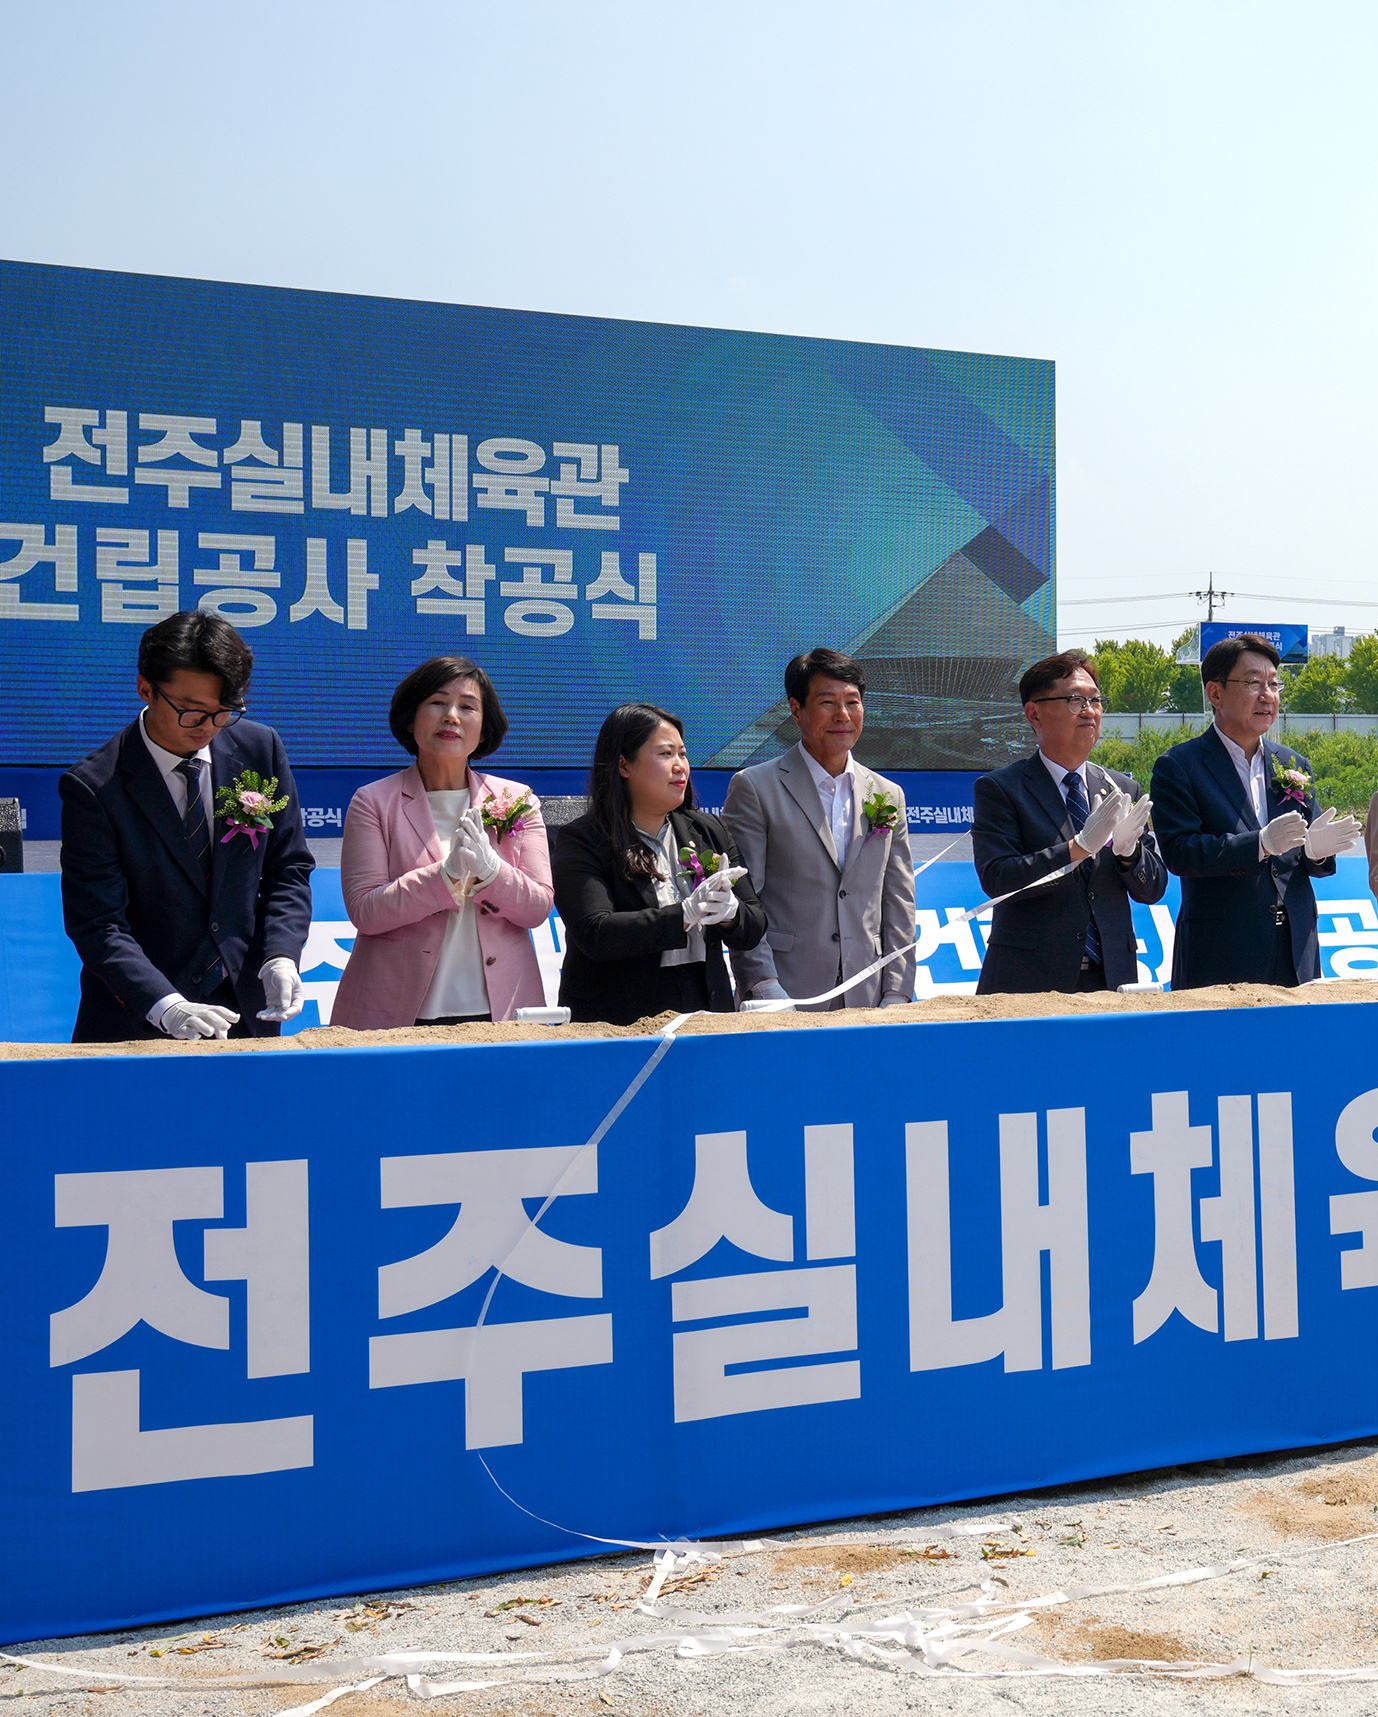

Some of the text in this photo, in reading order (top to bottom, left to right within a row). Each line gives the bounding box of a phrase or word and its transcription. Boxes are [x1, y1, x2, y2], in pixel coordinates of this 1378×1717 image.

[42, 406, 630, 532] 전주실내체육관
[0, 523, 659, 641] 건립공사 착공식
